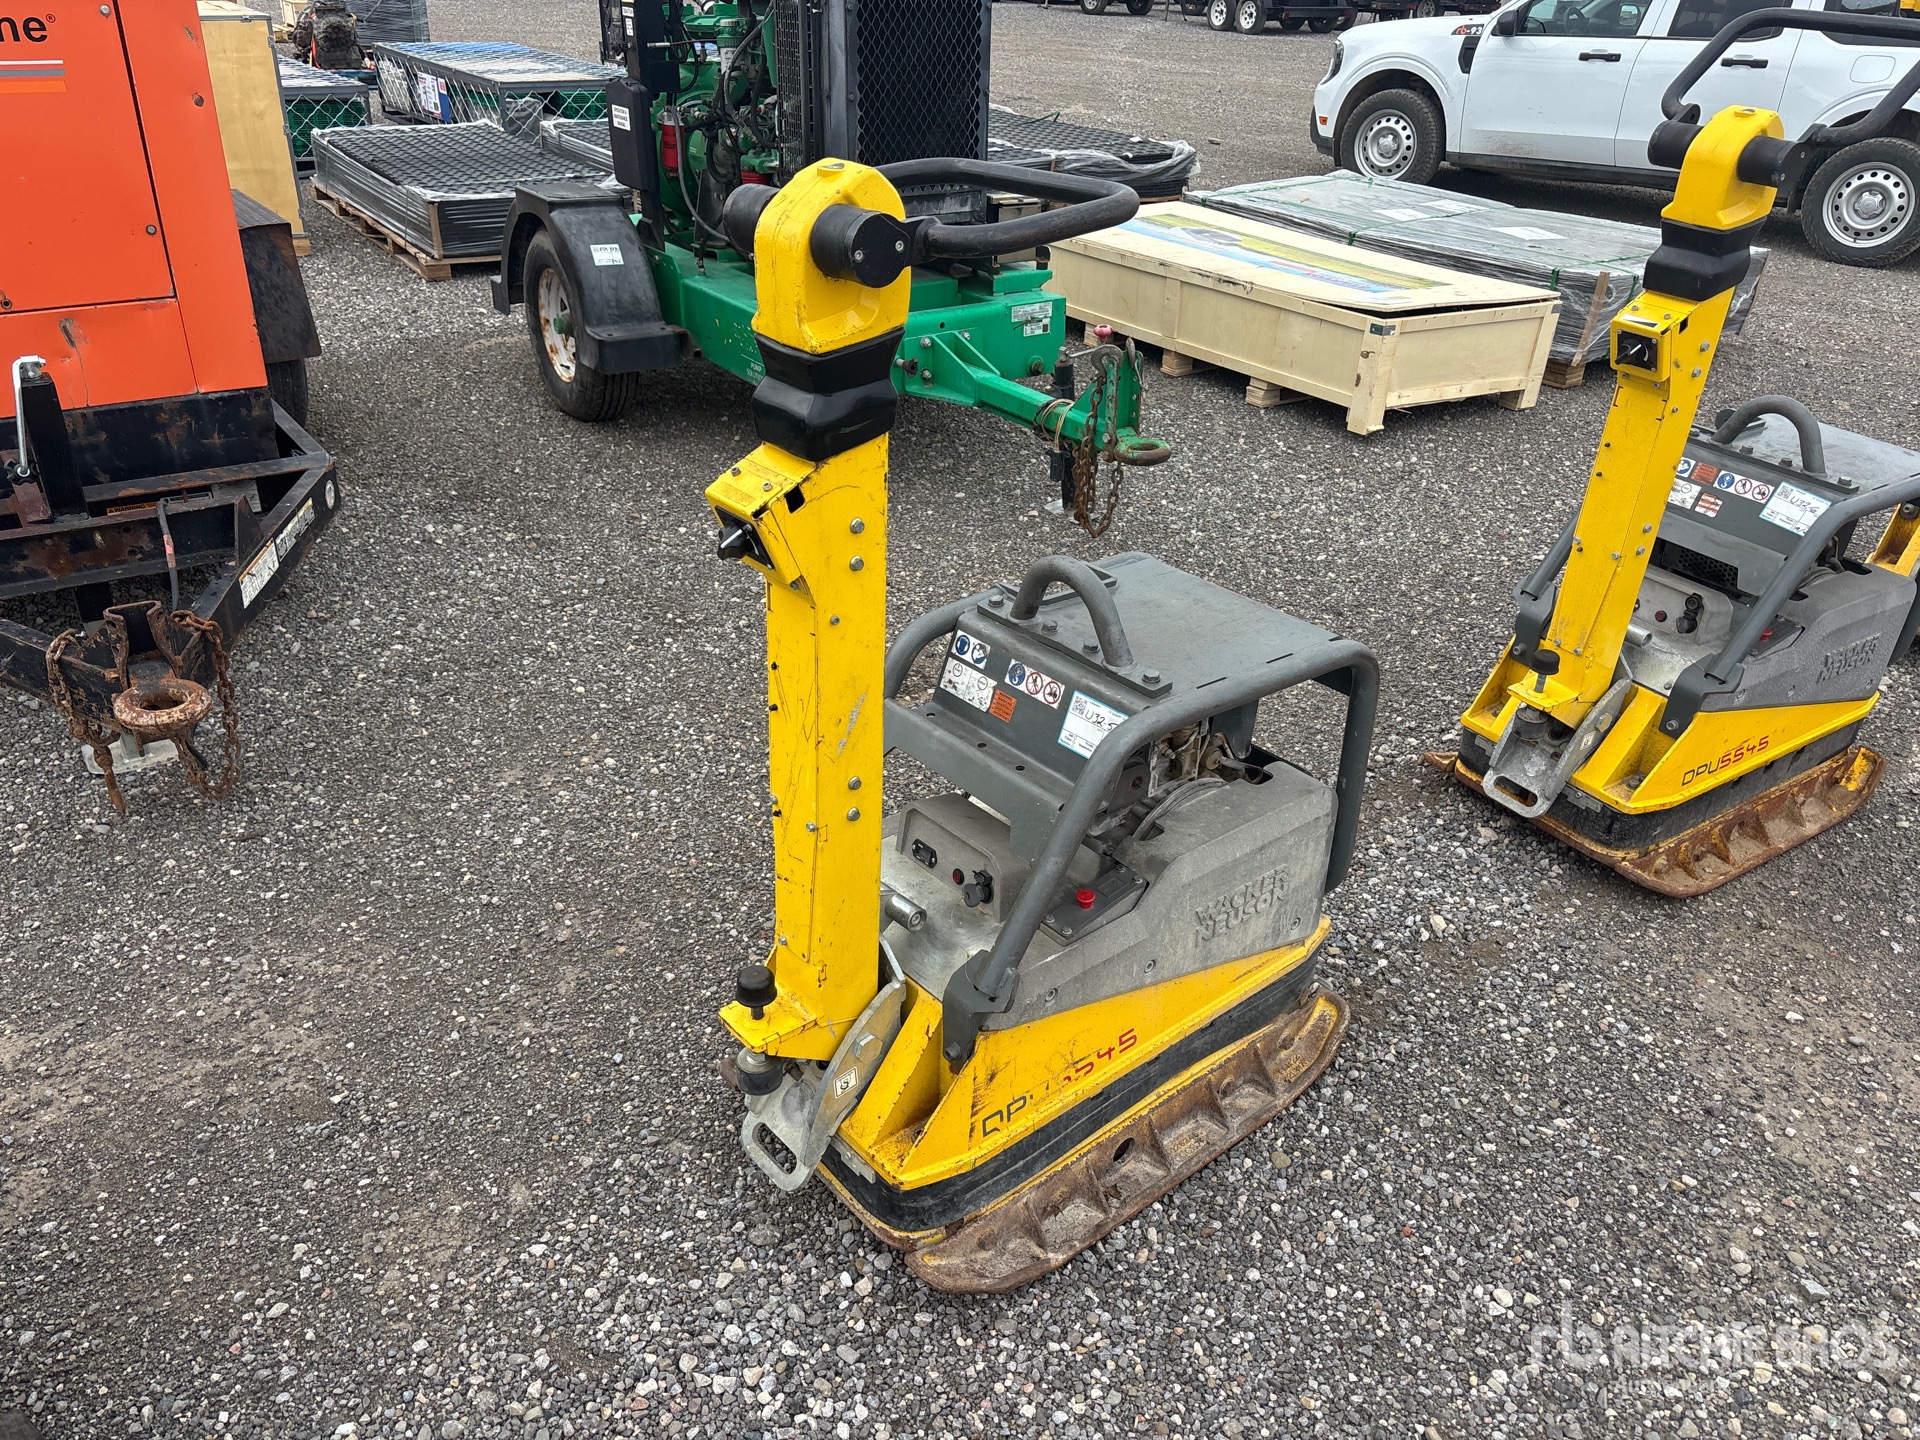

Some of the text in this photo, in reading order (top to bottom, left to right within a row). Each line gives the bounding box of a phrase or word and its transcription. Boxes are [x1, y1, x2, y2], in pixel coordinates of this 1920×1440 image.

[1681, 735, 1770, 787] DPU5545
[1195, 864, 1288, 926] WACKER
[1195, 889, 1283, 949] NEUSON
